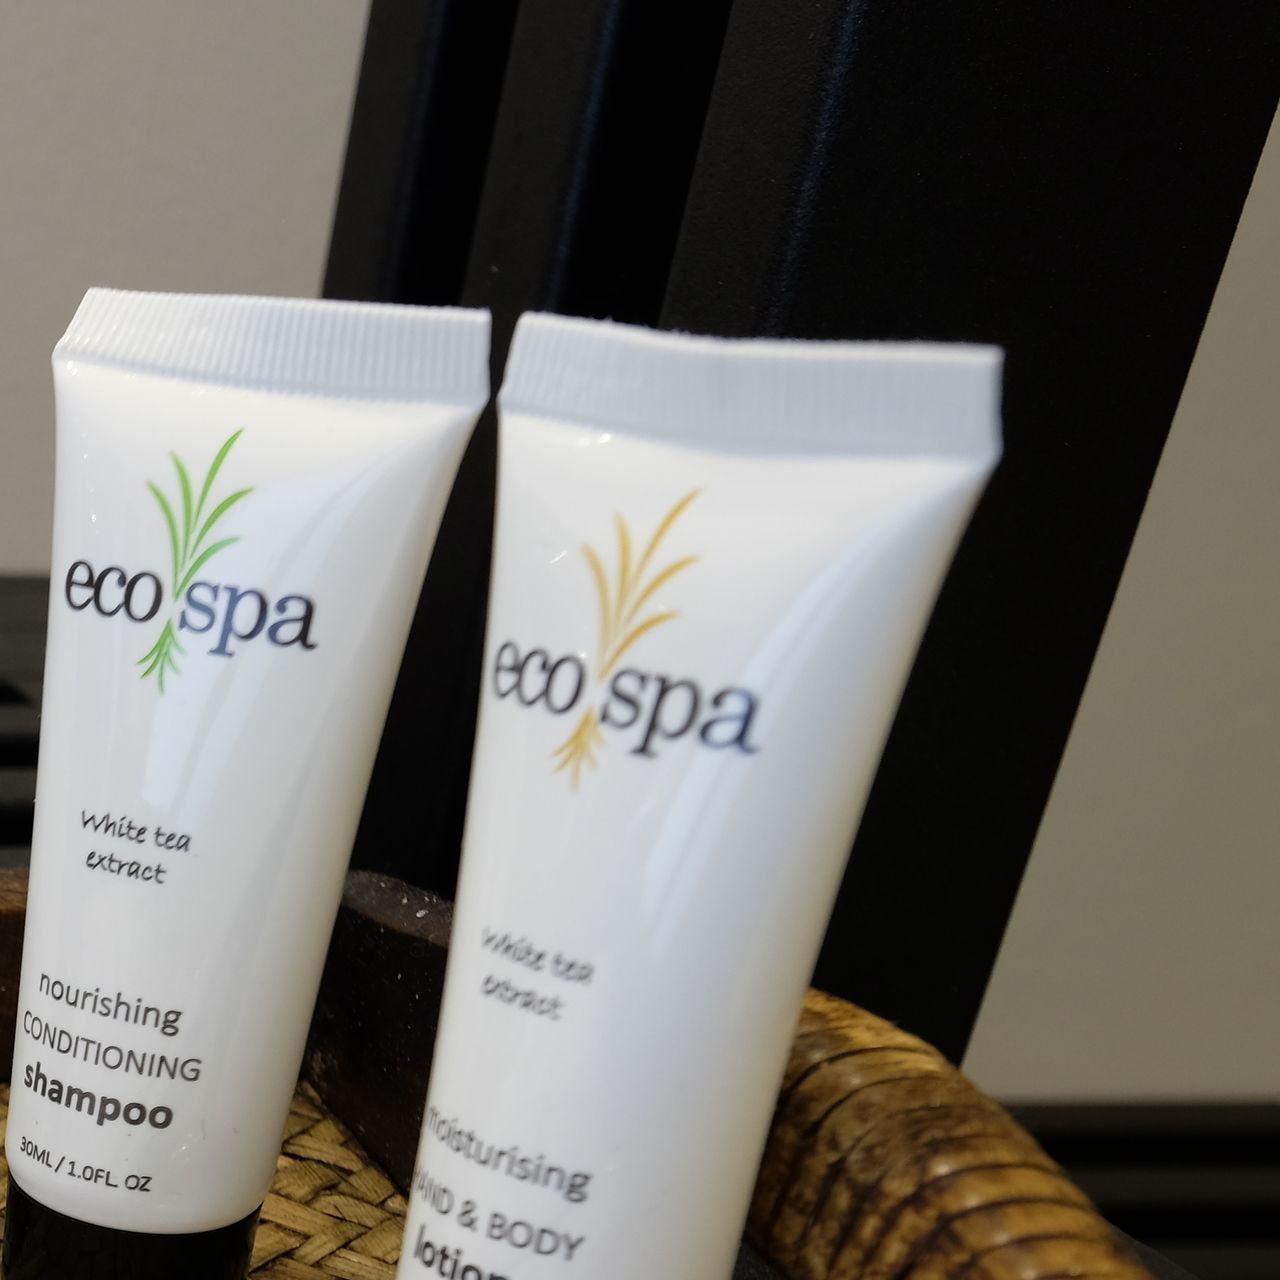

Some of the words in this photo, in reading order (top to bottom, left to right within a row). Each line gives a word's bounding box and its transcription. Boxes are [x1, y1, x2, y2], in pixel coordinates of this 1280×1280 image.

[64, 559, 163, 623] eco
[178, 579, 320, 658] spa
[493, 639, 588, 715] eco
[599, 666, 762, 760] spa
[81, 809, 146, 845] White
[154, 825, 192, 854] tea
[85, 849, 168, 885] extract
[39, 972, 183, 1037] nourishing
[23, 1009, 203, 1083] CONDITIONING
[24, 1061, 175, 1130] shampoo
[20, 1136, 53, 1169] 30ML
[67, 1159, 119, 1188] 1.0FL
[125, 1173, 154, 1193] OZ
[486, 1211, 586, 1262] BODY
